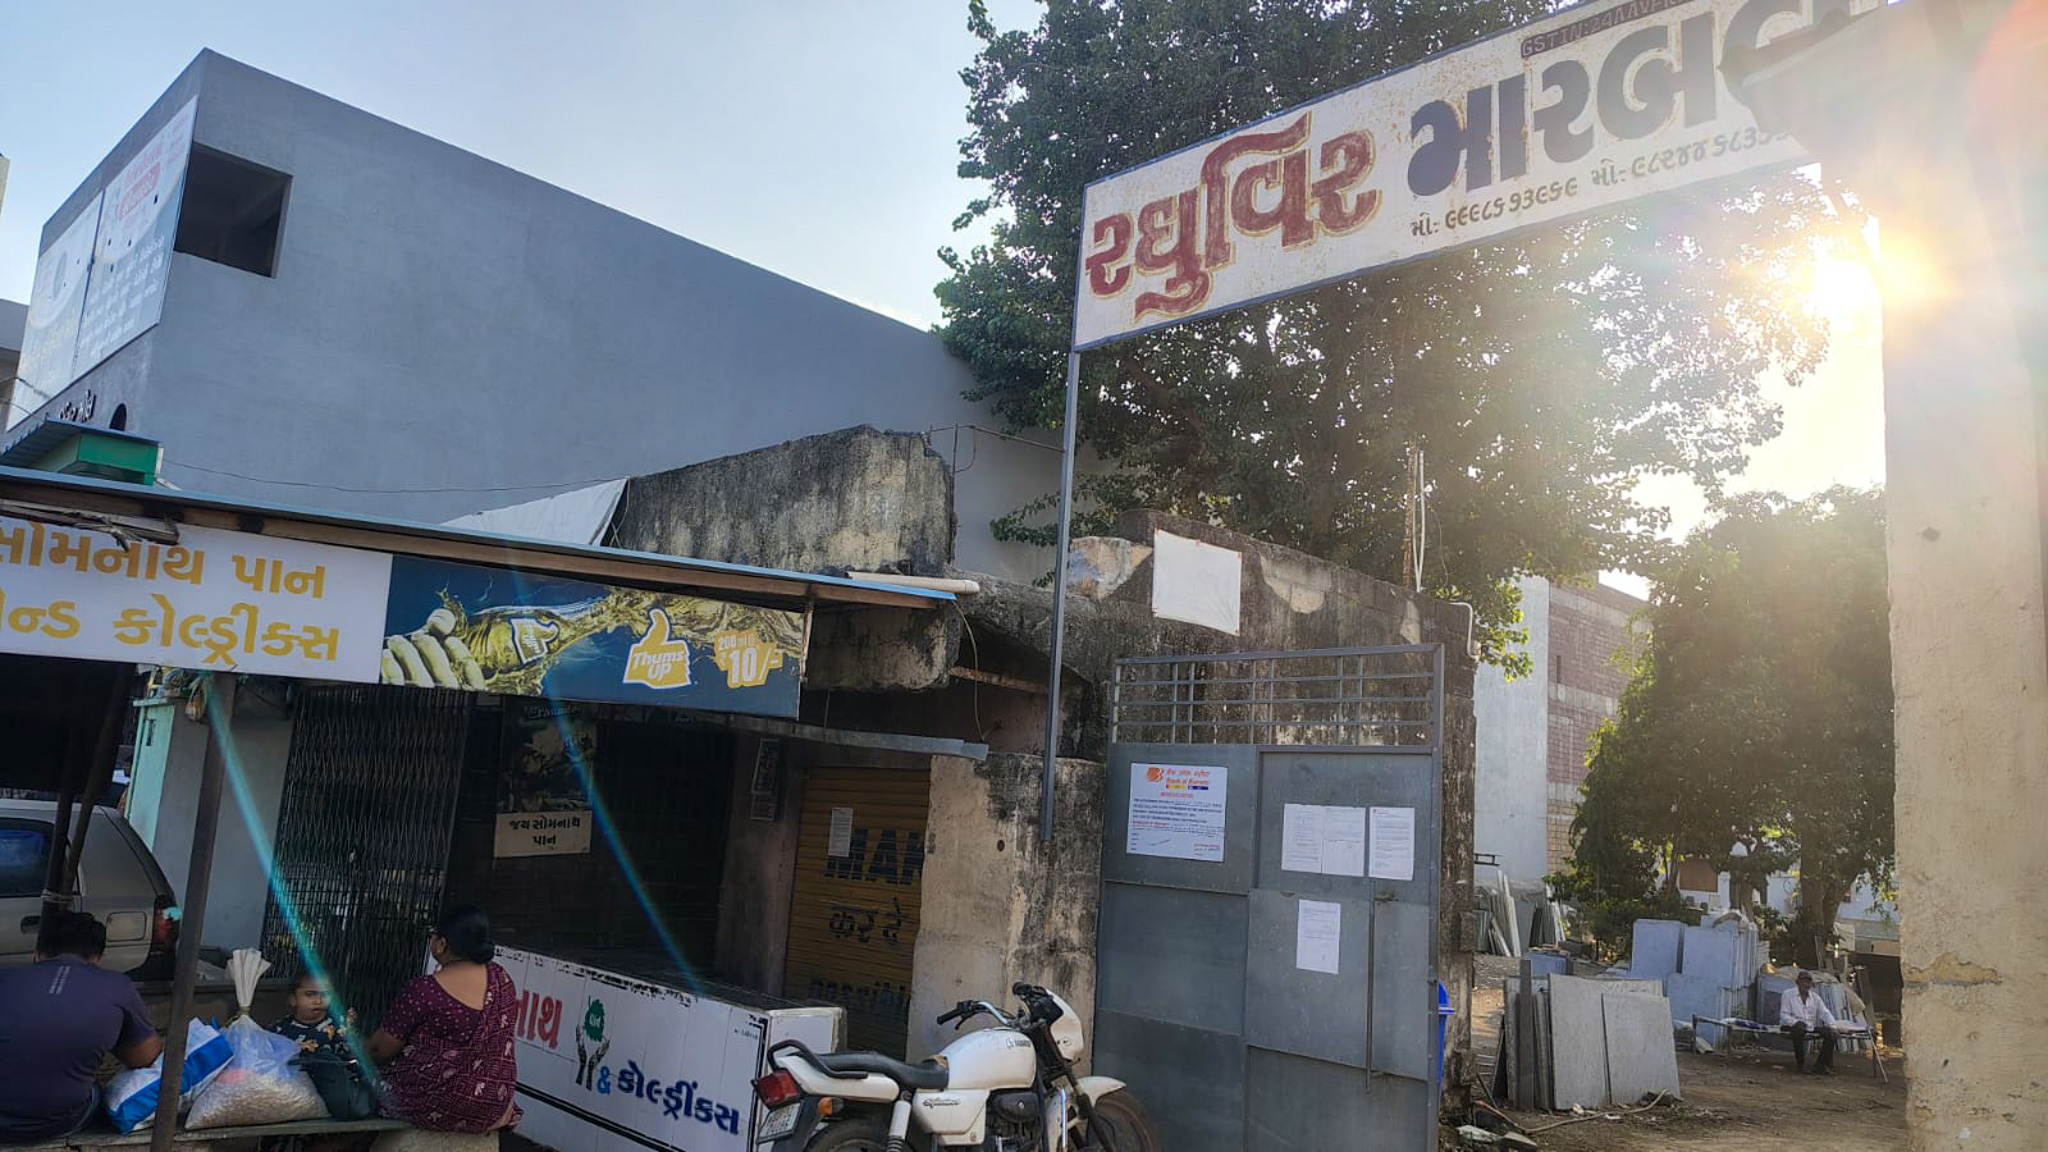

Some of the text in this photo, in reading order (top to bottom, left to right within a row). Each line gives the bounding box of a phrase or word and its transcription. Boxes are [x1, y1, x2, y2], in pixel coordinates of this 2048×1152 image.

[231, 554, 326, 599] પાન
[0, 587, 81, 639] ન્ડ
[532, 834, 556, 846] પાન
[597, 1064, 612, 1096] &
